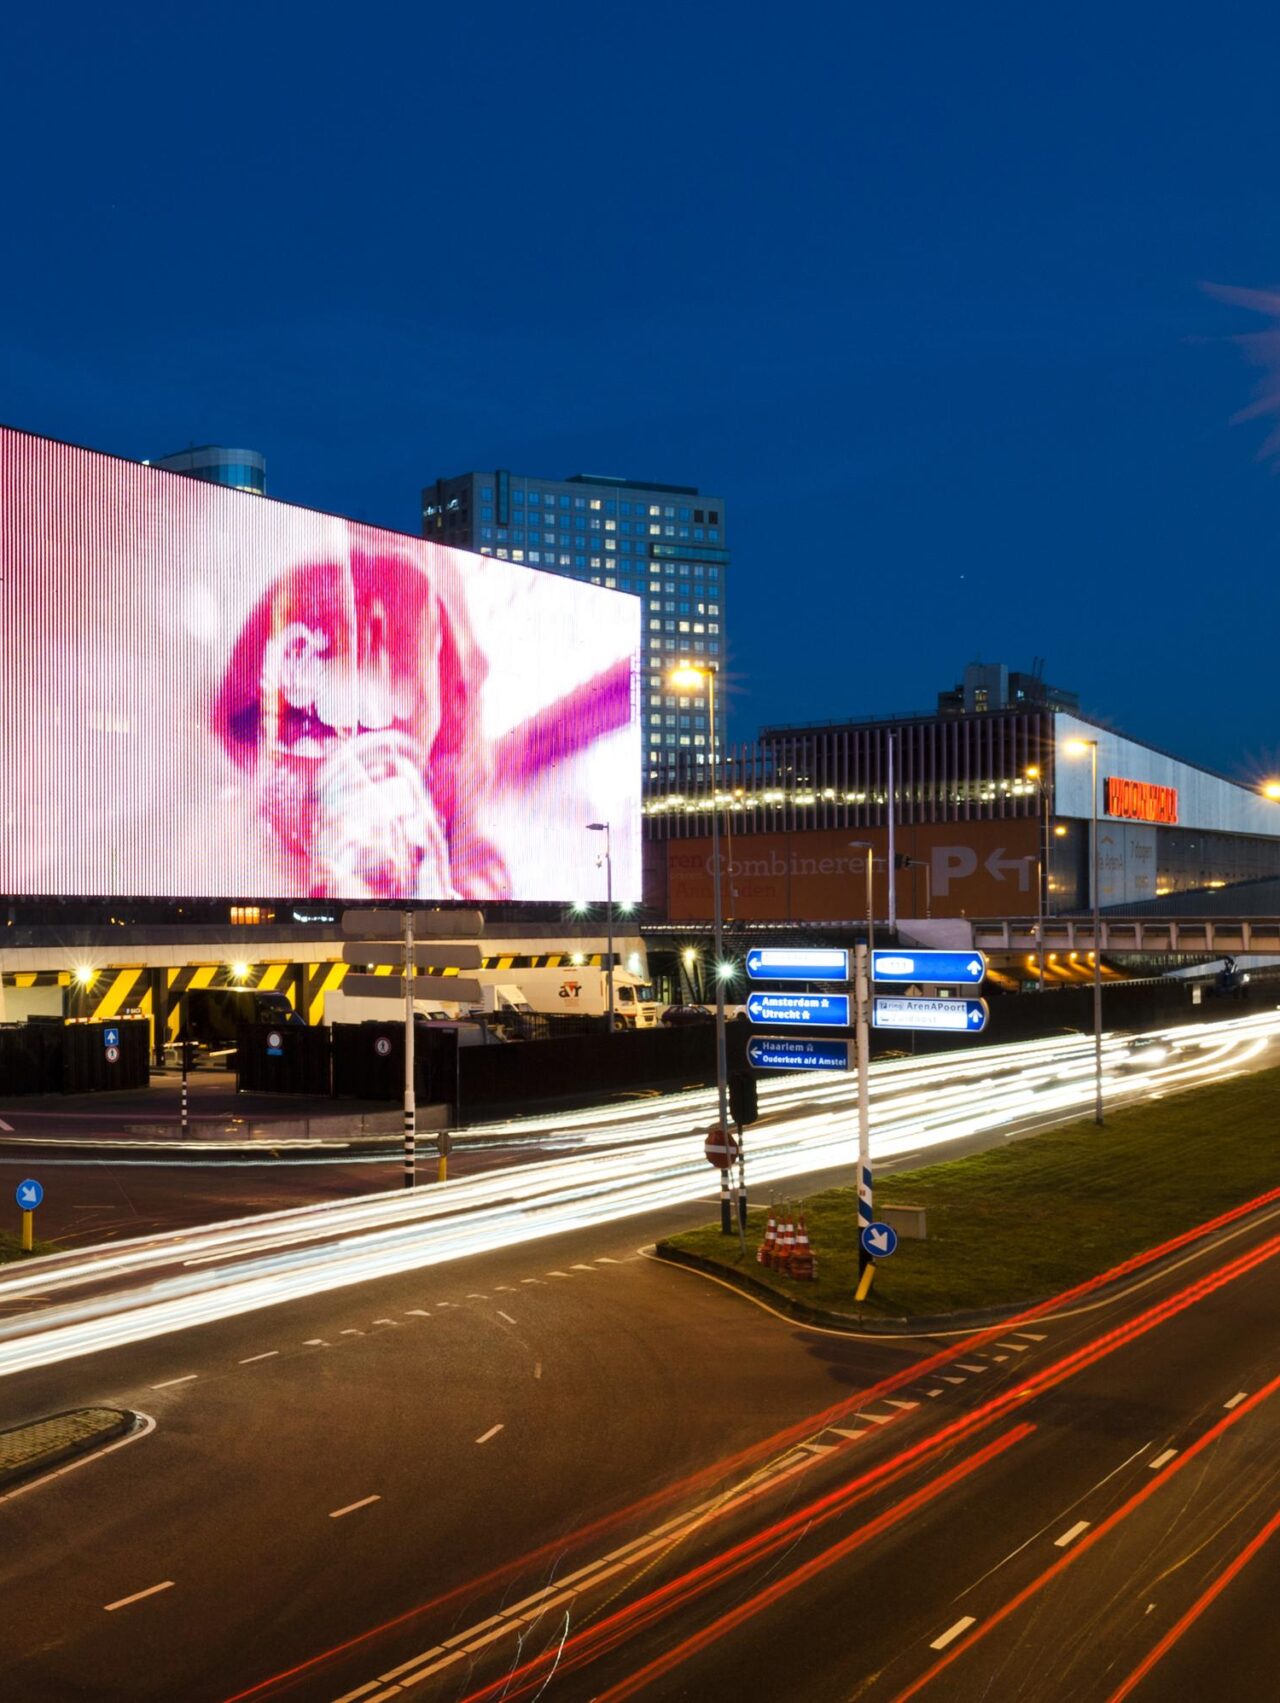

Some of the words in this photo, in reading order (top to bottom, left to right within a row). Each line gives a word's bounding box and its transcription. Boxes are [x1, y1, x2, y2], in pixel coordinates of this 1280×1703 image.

[705, 850, 885, 877] Combineren
[931, 846, 978, 897] P
[762, 996, 820, 1008] Amsterdam
[906, 1002, 966, 1012] ArenAPoort
[762, 1008, 801, 1020] Utrecht
[762, 1041, 804, 1052] Haarlem
[762, 1055, 803, 1065] Ouderkerk
[803, 1056, 817, 1065] a/d
[818, 1057, 847, 1066] Amstel
